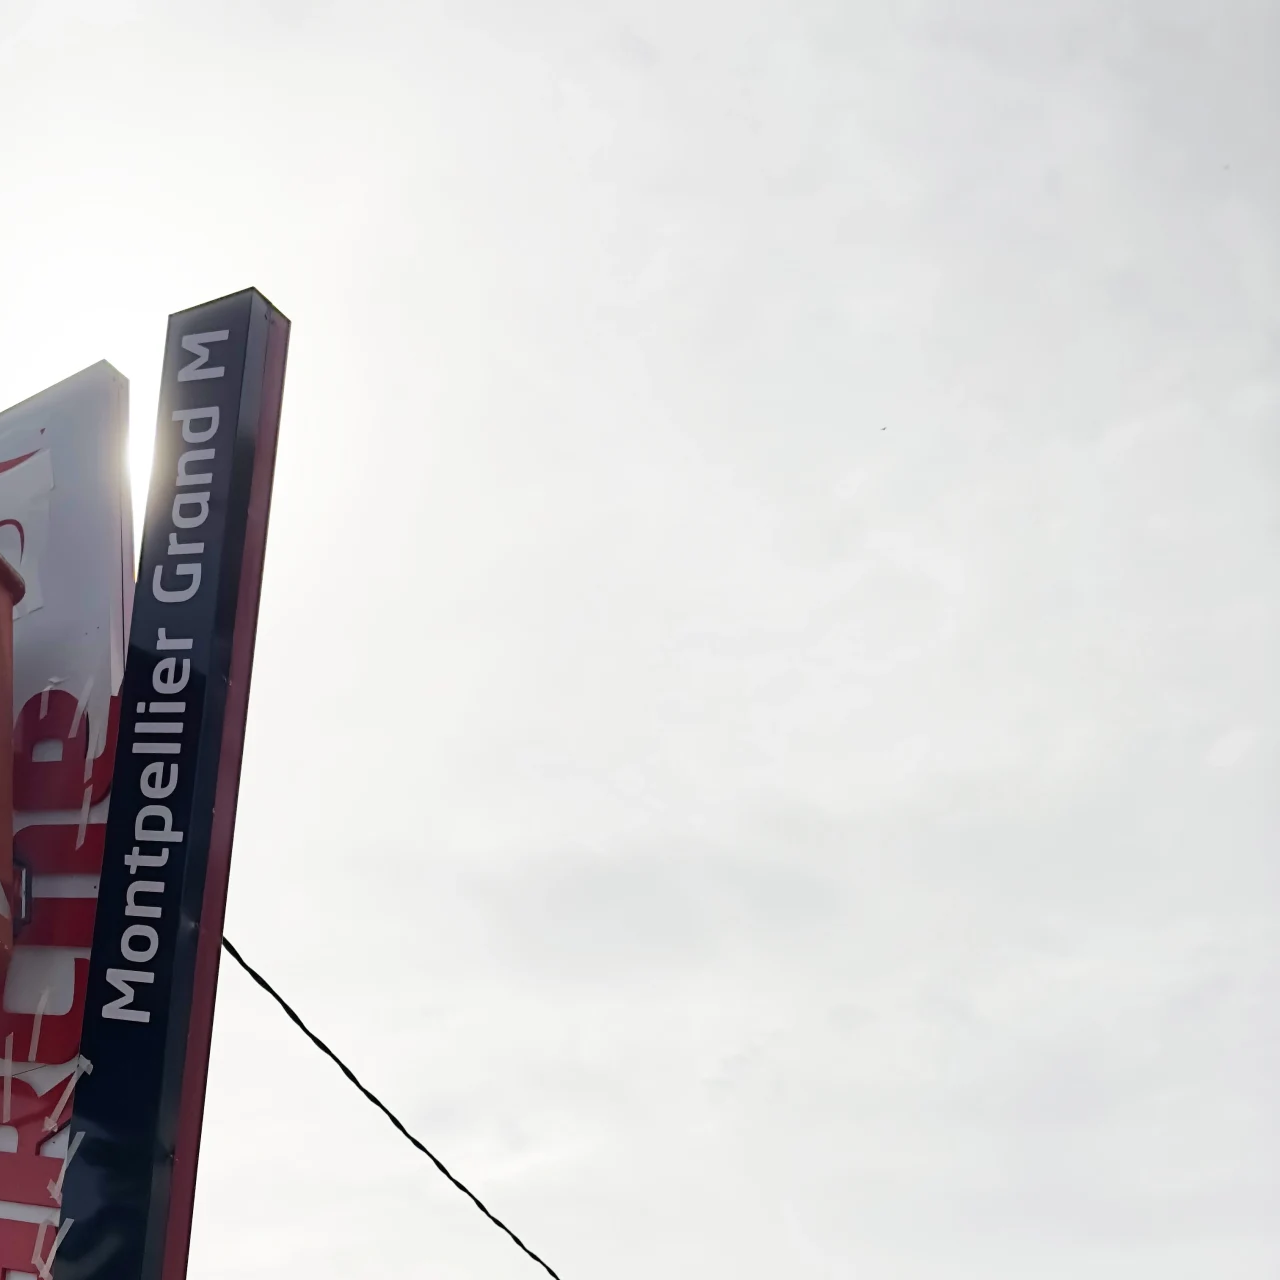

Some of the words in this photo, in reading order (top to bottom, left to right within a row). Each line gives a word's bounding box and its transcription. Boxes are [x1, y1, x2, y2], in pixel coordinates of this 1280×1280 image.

[177, 329, 231, 383] M
[151, 405, 220, 604] Grand
[101, 627, 194, 1023] Montpellier
